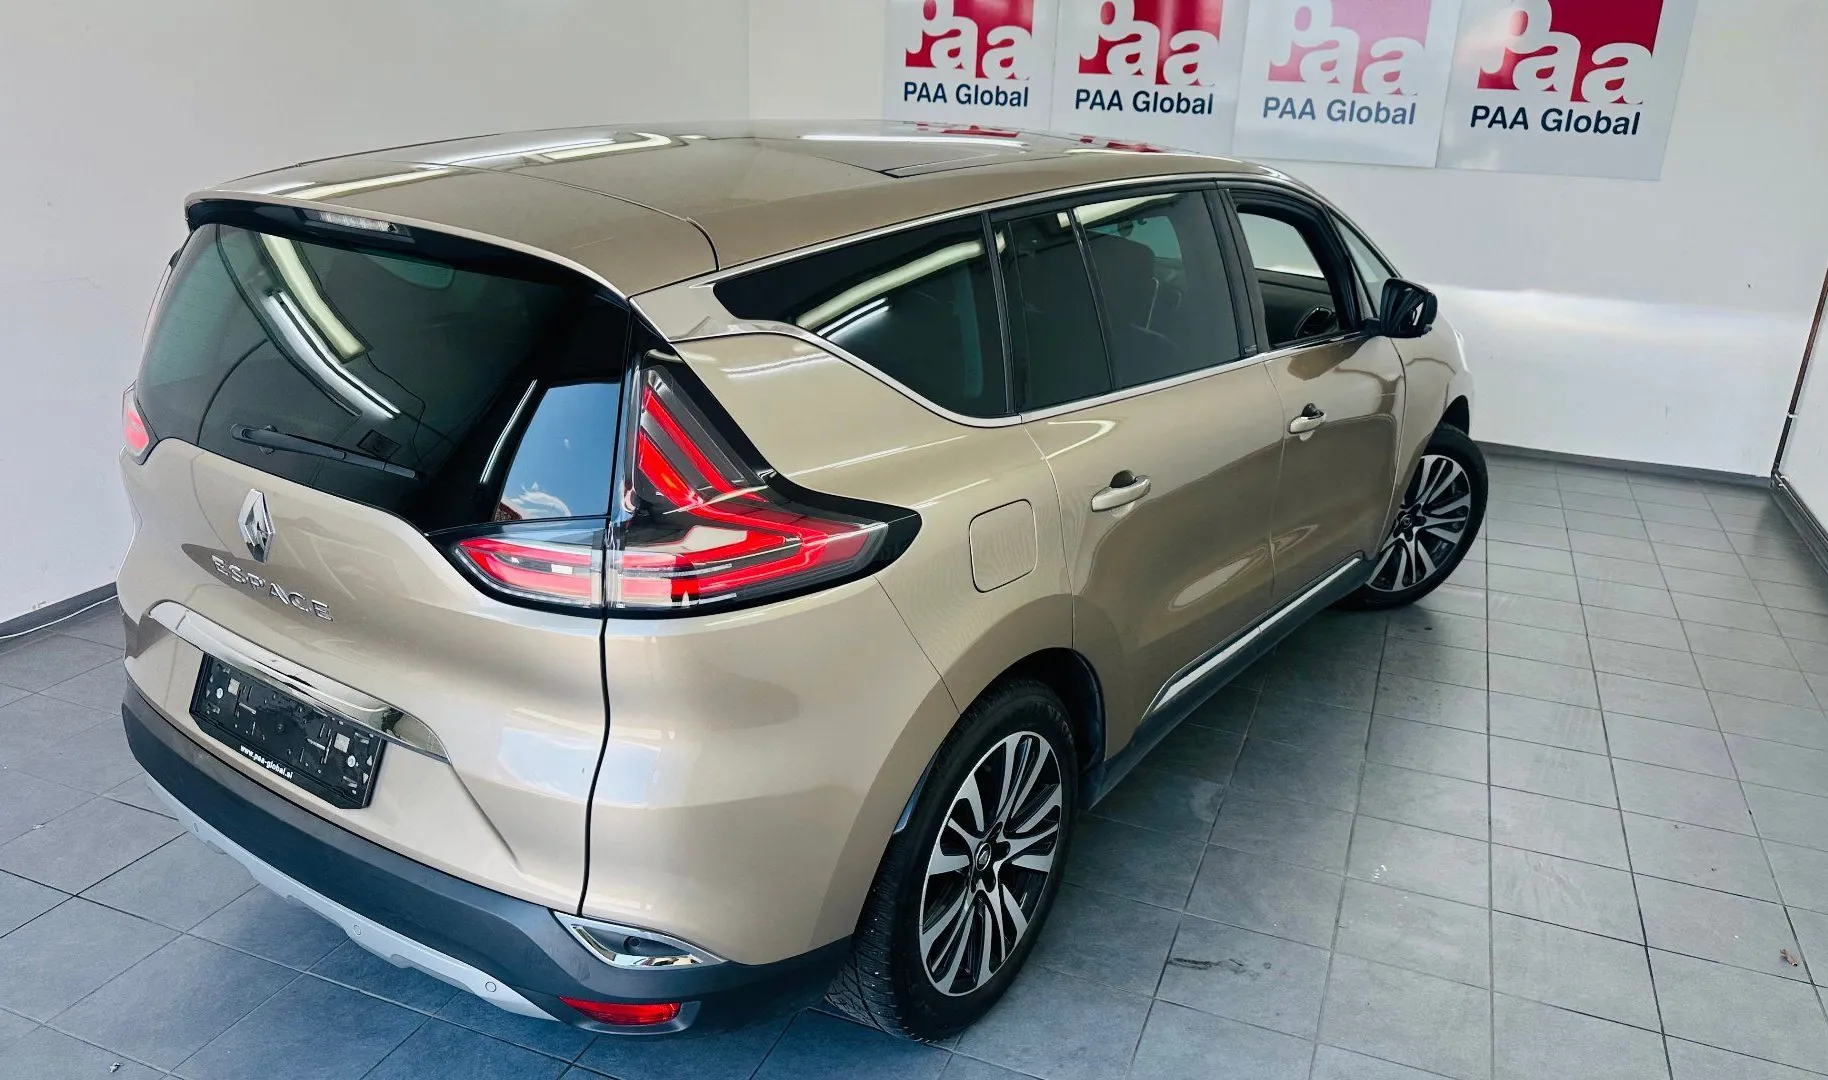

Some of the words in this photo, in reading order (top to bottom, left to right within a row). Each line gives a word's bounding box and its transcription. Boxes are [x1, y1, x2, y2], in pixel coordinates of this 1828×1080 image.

[904, 81, 948, 104] PAA
[955, 83, 1029, 108] Global
[1075, 88, 1123, 111] PAA
[1132, 90, 1214, 115] Global
[1262, 96, 1316, 120] PAA
[1326, 98, 1416, 125] Global
[1470, 105, 1529, 130] PAA
[1540, 107, 1641, 136] Global
[211, 554, 335, 622] ESPACE
